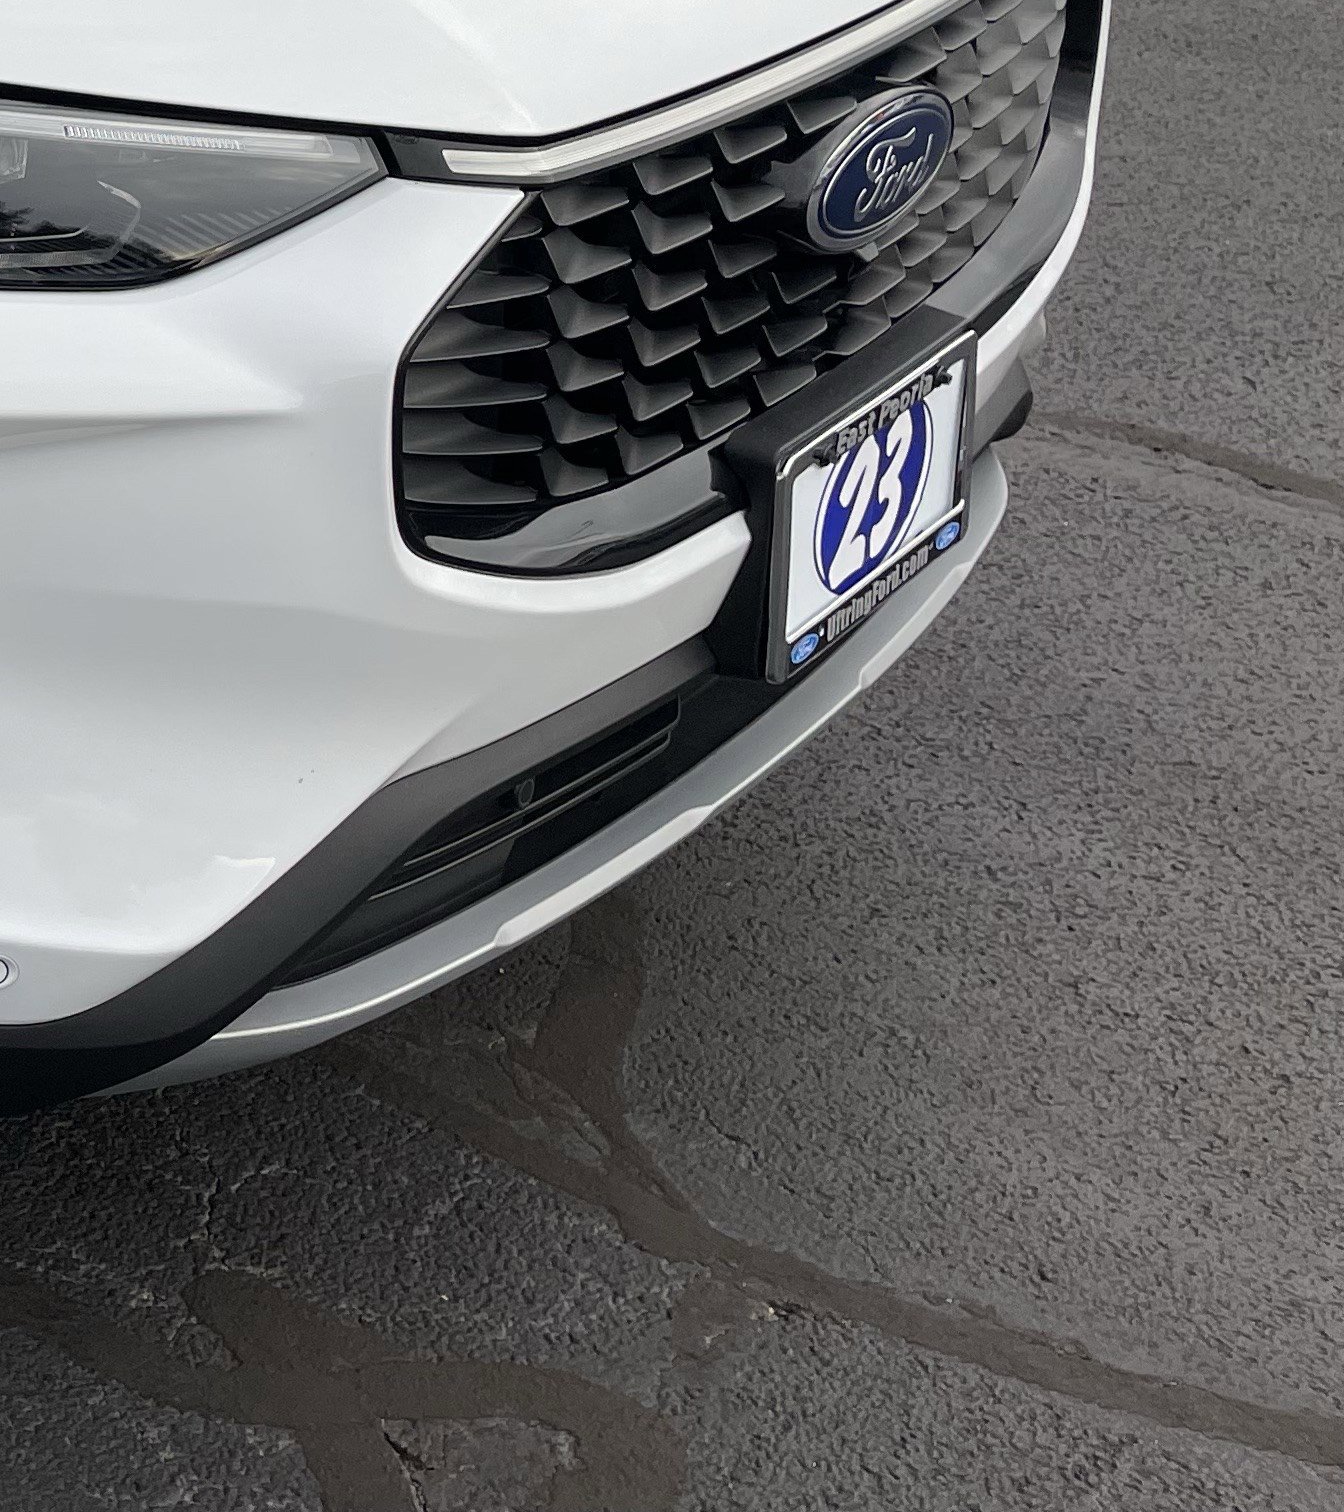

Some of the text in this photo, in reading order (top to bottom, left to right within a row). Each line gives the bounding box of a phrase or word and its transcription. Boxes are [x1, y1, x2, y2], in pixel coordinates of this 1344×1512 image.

[854, 127, 934, 223] Ford
[836, 372, 934, 456] East Peoria
[828, 408, 913, 590] 23
